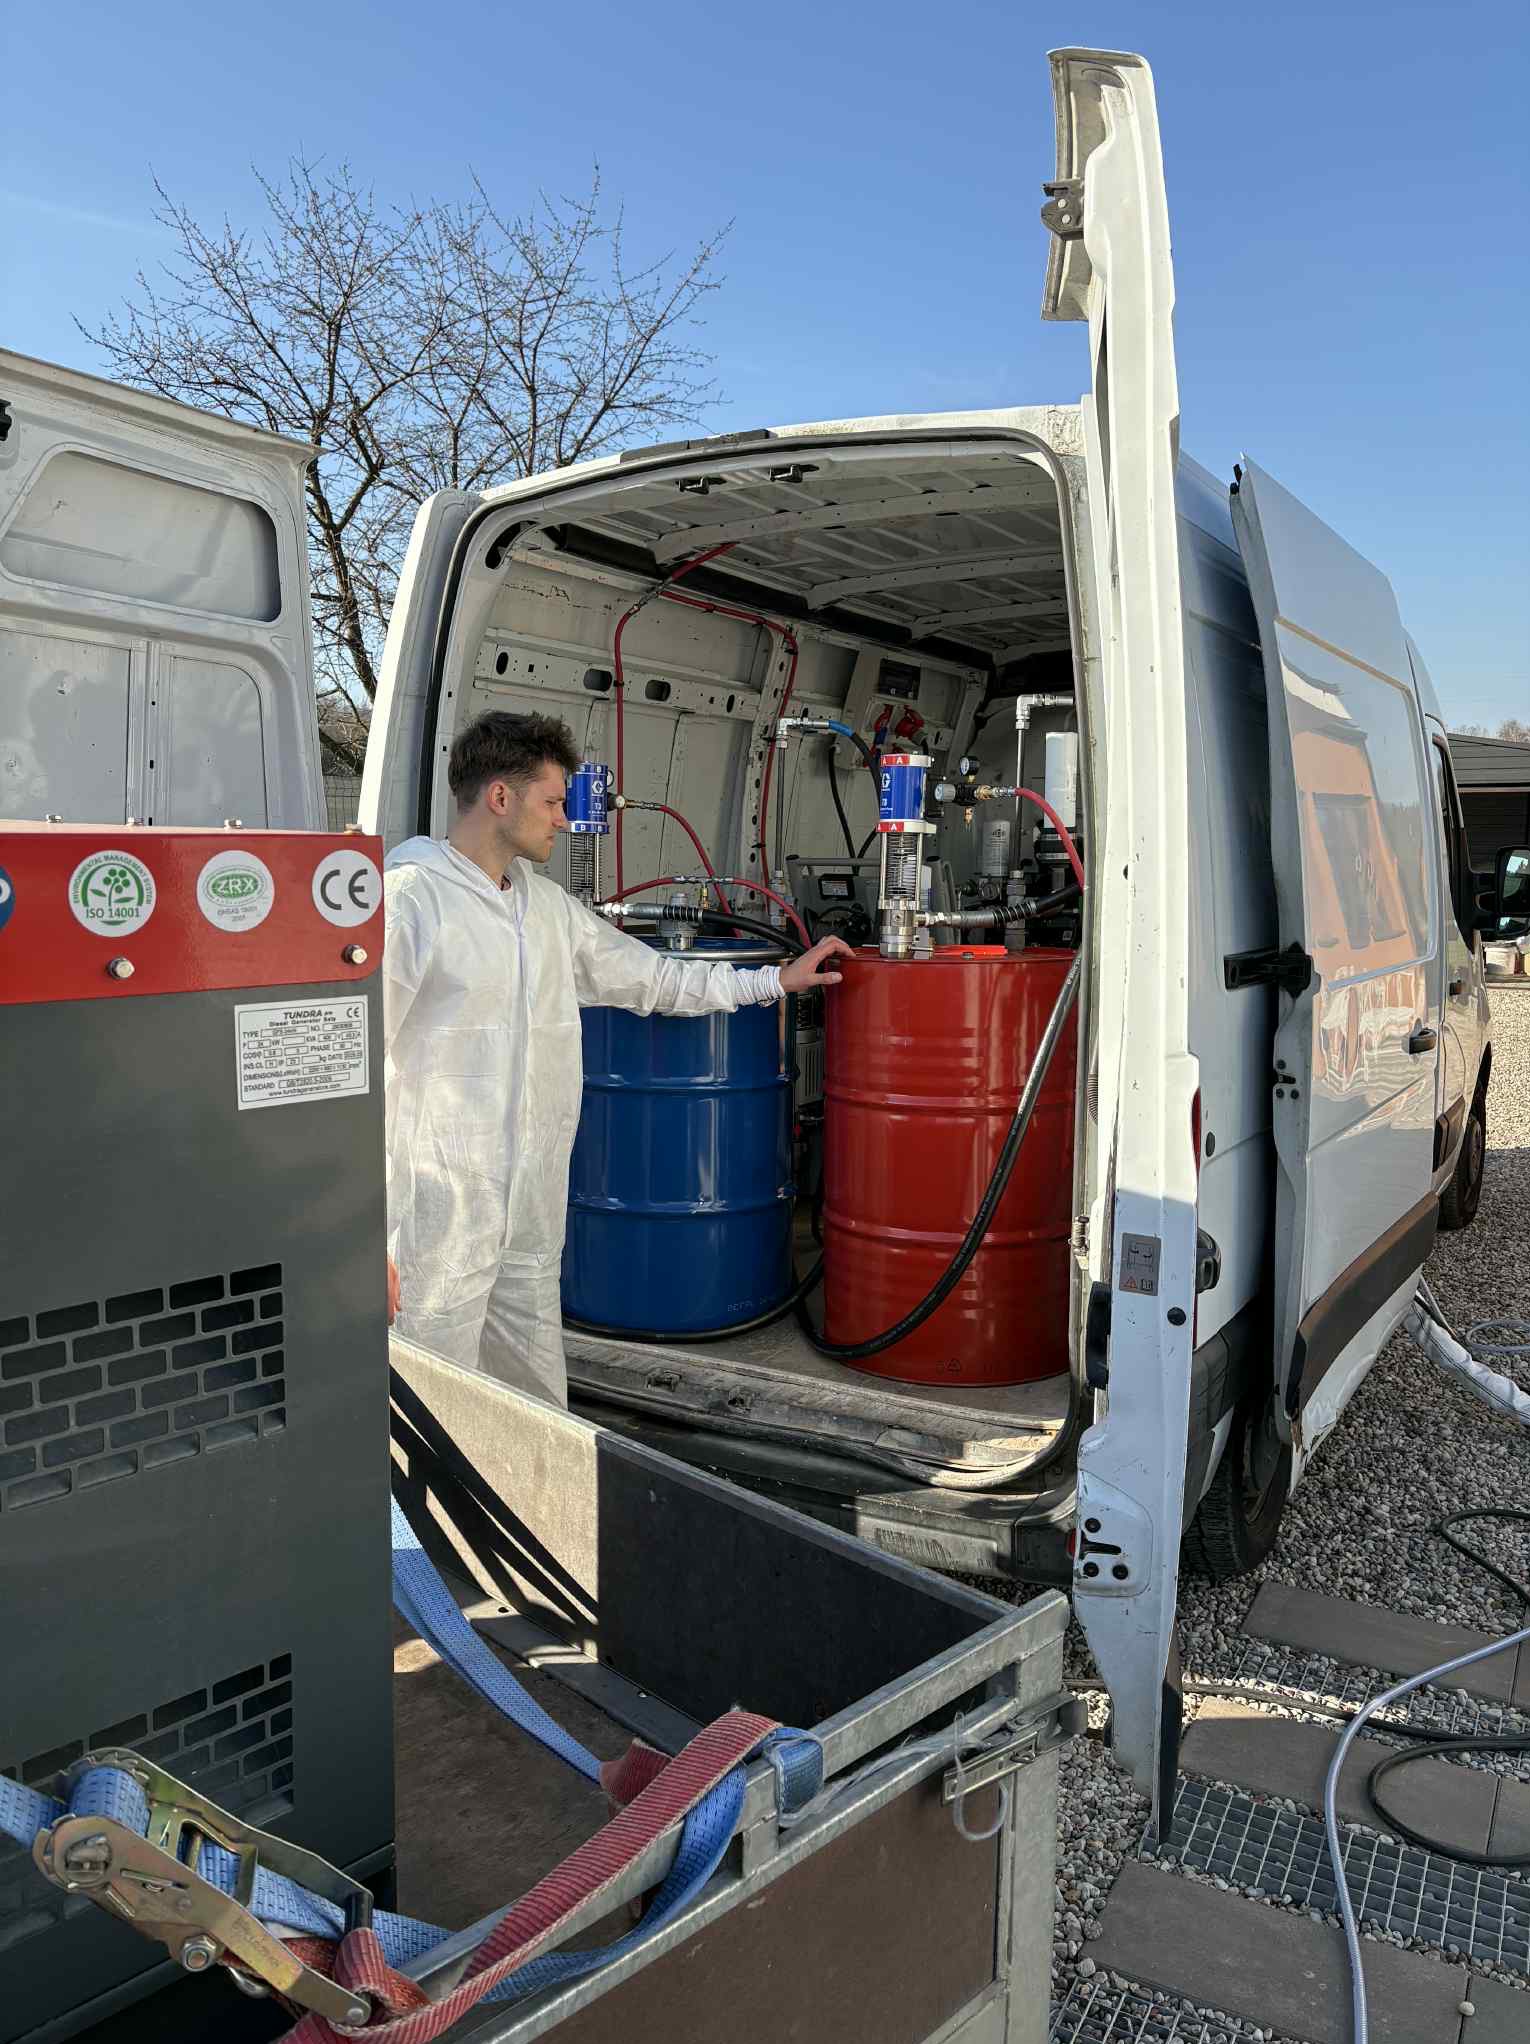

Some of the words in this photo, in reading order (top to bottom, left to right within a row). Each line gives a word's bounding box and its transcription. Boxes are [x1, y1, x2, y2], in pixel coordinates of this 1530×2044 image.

[896, 756, 903, 764] A
[890, 823, 897, 831] A
[217, 877, 255, 894] ZRX
[320, 868, 370, 911] CE
[86, 907, 105, 918] ISO
[108, 907, 140, 918] 14001
[283, 1009, 322, 1019] TUNDRA
[346, 1007, 360, 1018] CE
[242, 1031, 259, 1039] TYPE
